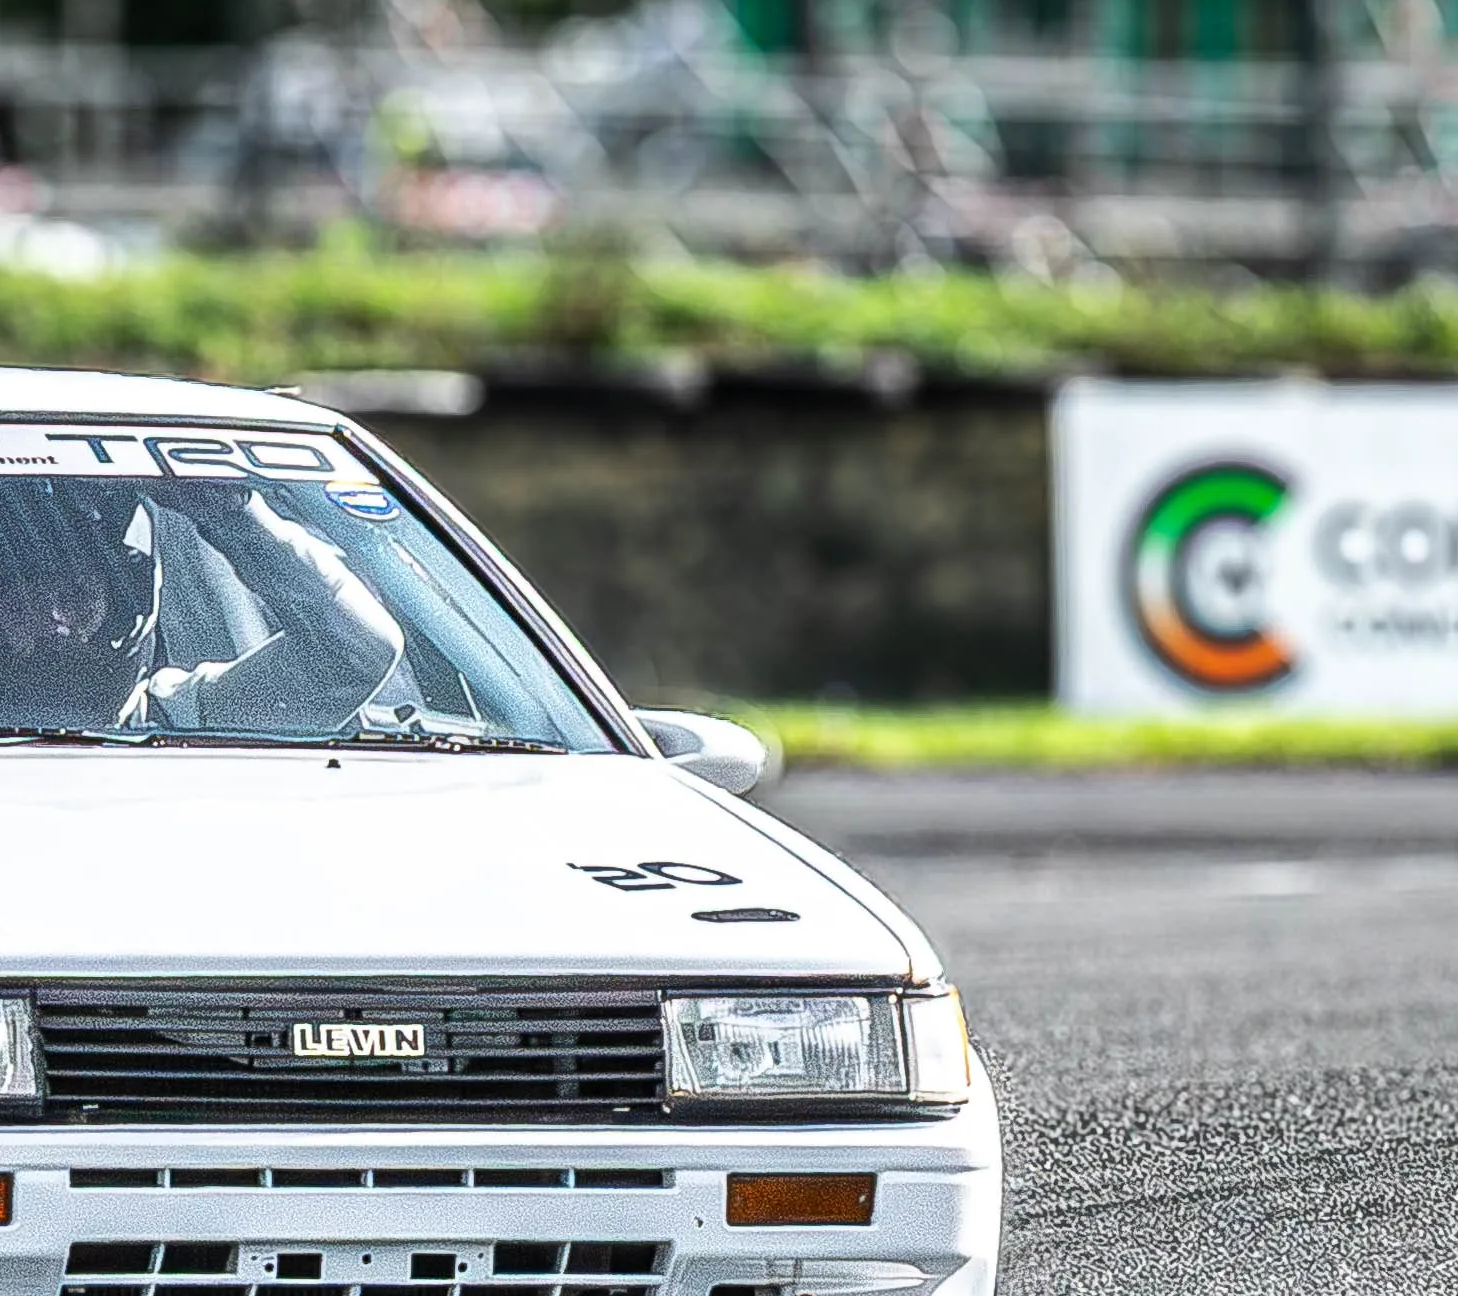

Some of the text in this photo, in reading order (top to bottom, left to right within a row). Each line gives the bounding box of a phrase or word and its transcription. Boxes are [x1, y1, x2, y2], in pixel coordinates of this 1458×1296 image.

[45, 433, 336, 481] TRD
[566, 861, 744, 892] 20
[293, 1023, 425, 1057] LEVIN
